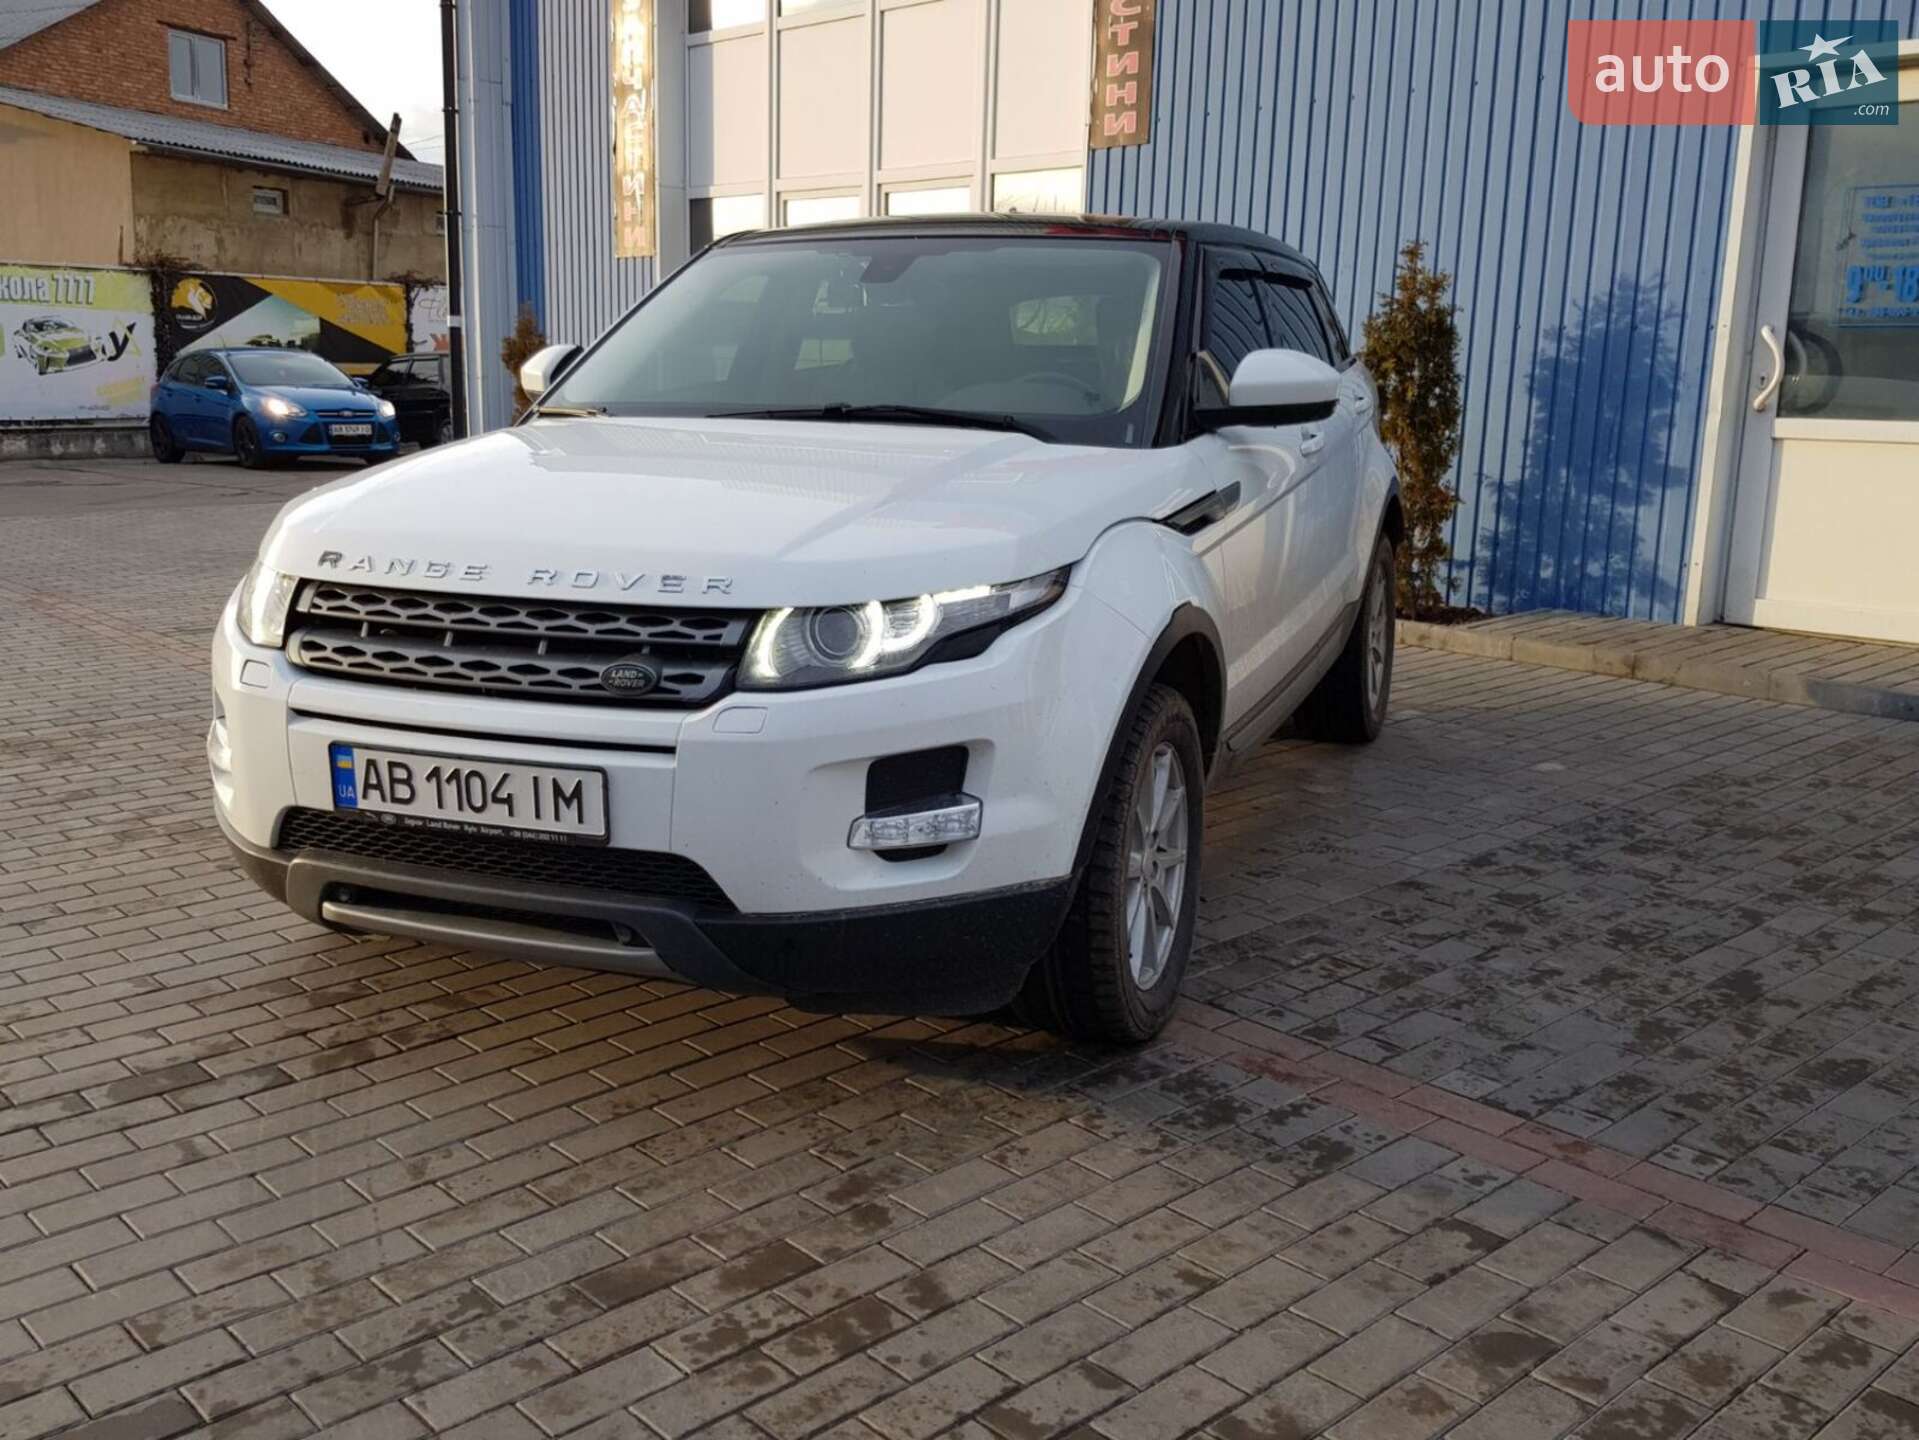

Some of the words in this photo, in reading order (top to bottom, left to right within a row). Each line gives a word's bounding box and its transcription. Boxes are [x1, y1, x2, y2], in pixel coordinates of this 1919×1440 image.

[317, 550, 490, 581] RANGE
[527, 567, 736, 596] ROVER
[611, 669, 638, 679] LAND
[613, 679, 646, 689] ROVER
[337, 783, 356, 800] UA
[361, 758, 417, 806] AB
[424, 765, 515, 818] 1104
[532, 775, 585, 825] IM
